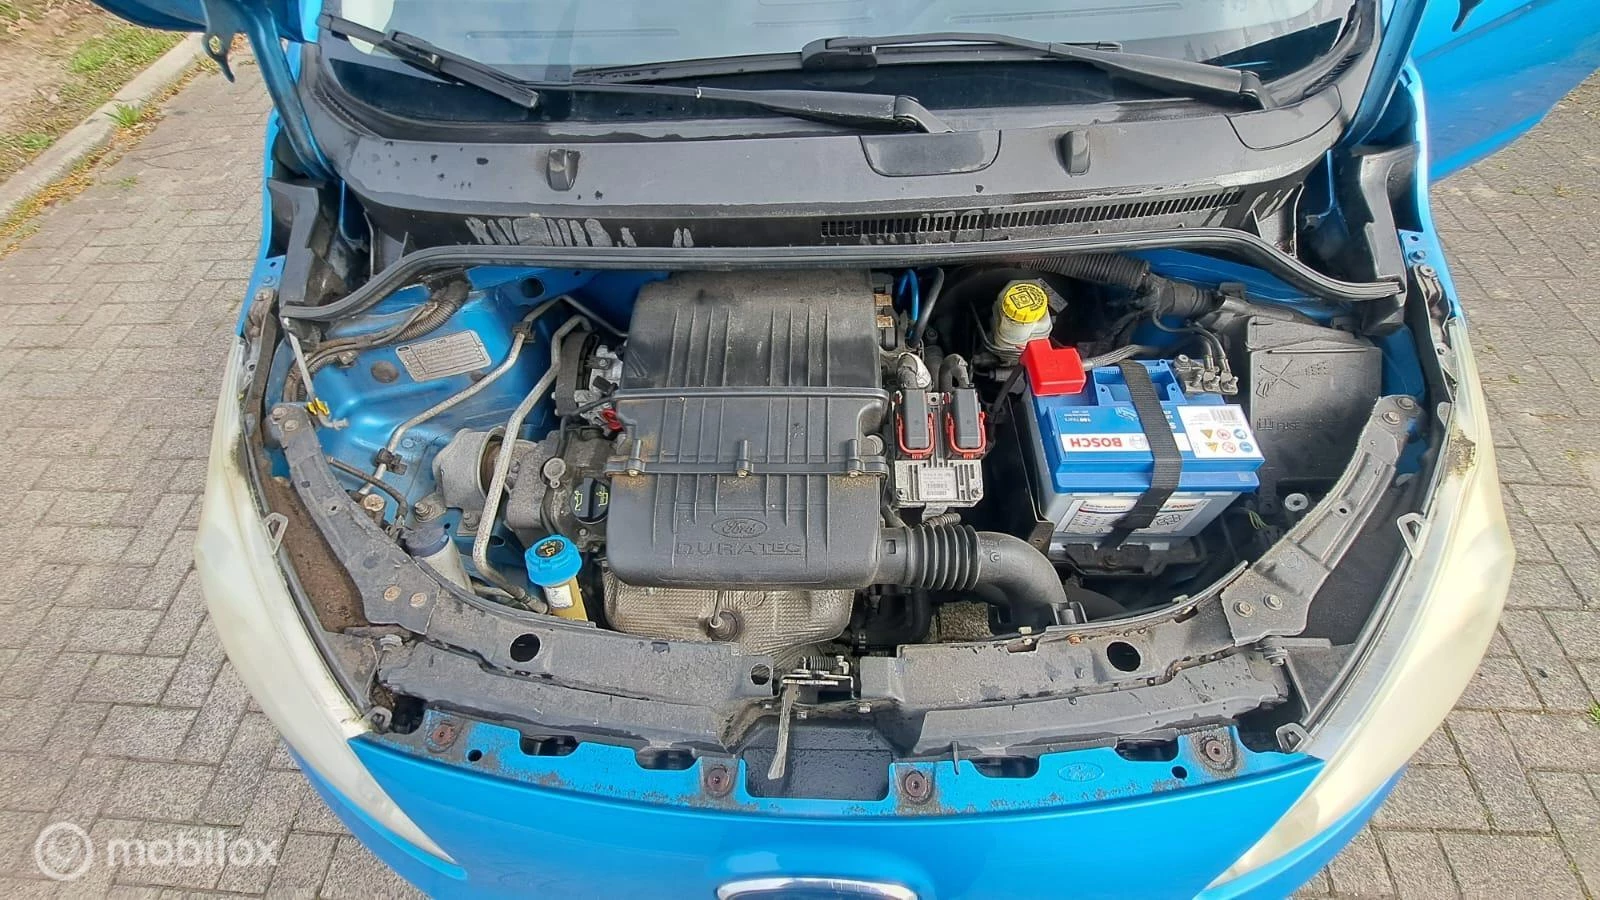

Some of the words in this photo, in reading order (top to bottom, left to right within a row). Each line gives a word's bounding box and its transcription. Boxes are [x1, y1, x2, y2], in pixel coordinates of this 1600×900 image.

[1070, 436, 1122, 448] BOSCH
[721, 520, 757, 534] Ford
[676, 541, 802, 556] DURATEC
